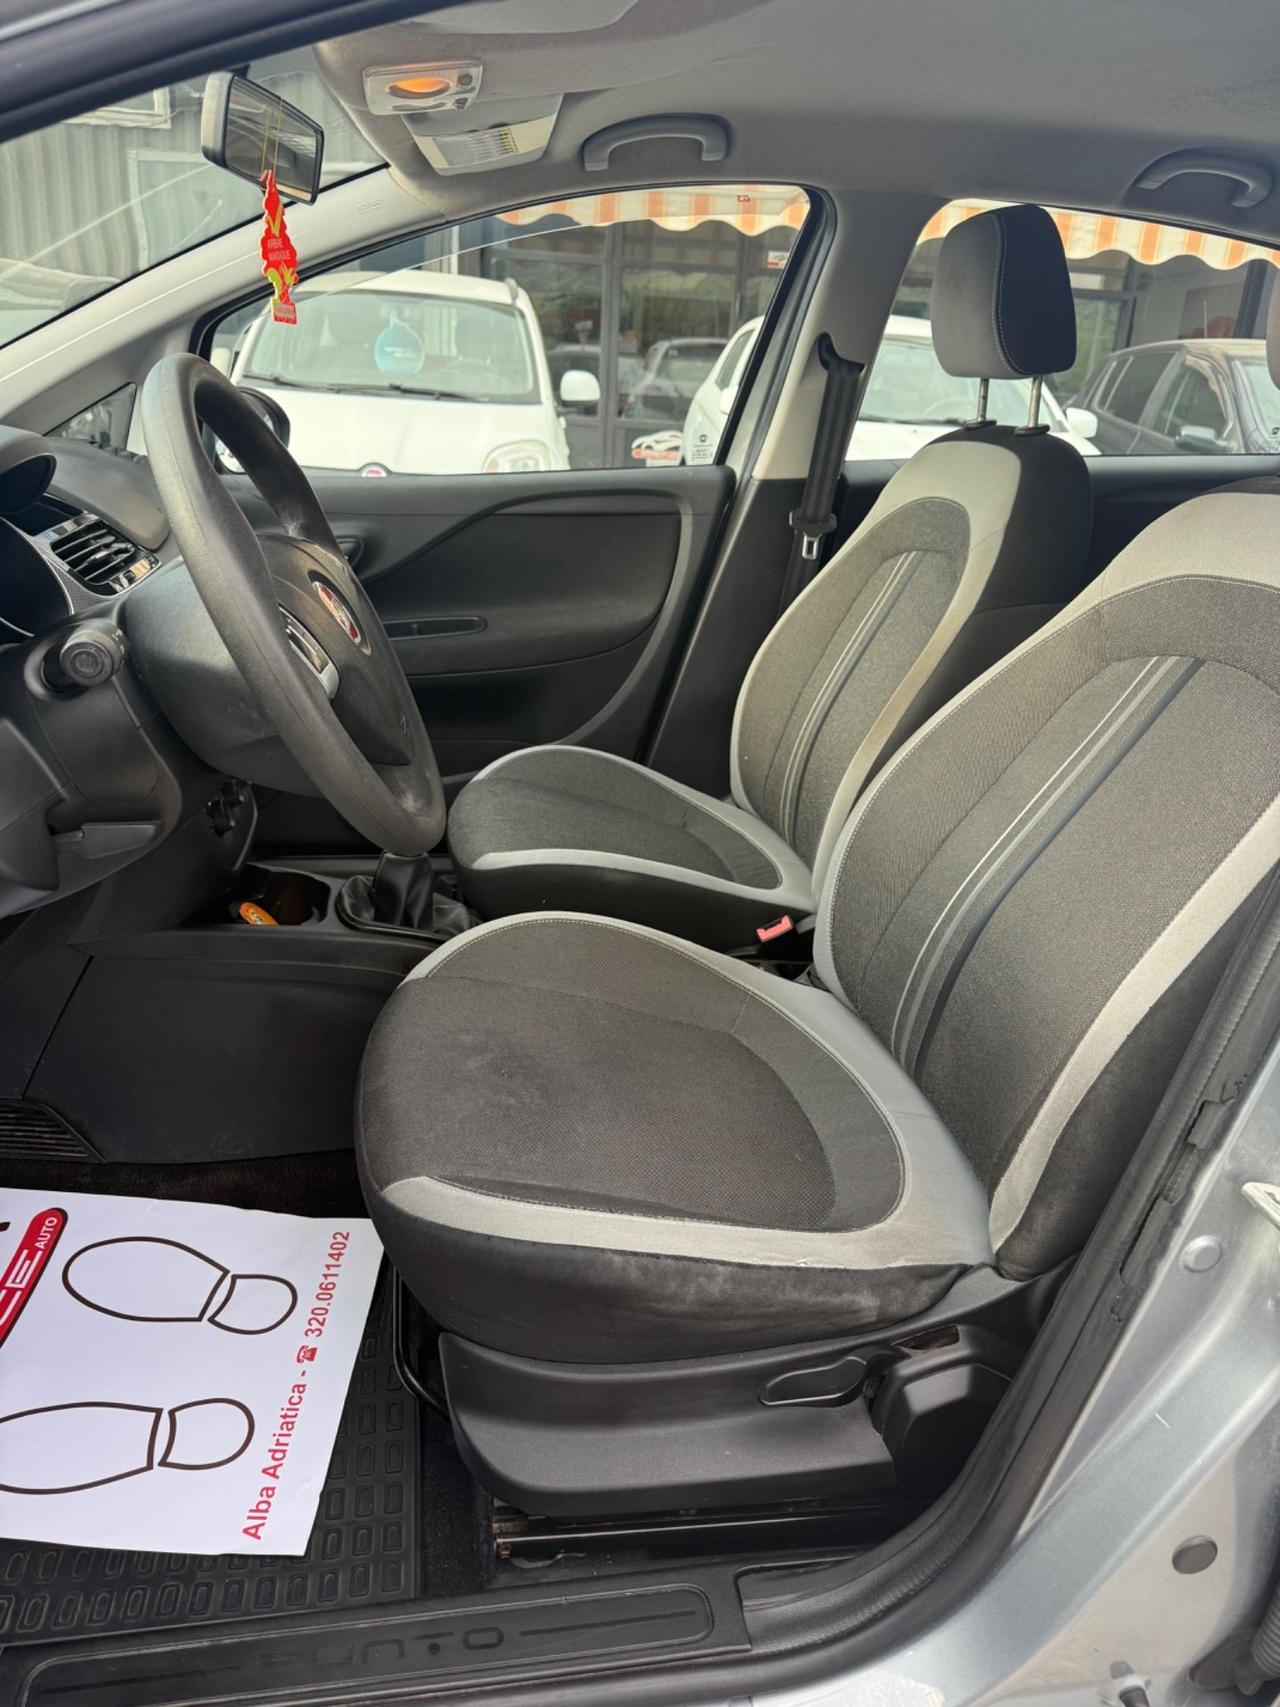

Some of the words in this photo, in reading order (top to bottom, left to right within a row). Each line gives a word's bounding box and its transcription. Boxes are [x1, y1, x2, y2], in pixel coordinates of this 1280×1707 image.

[34, 1217, 58, 1250] AUTO
[242, 1486, 276, 1540] Alba
[261, 1384, 306, 1479] Adriatica
[304, 1231, 350, 1337] 320.0611402
